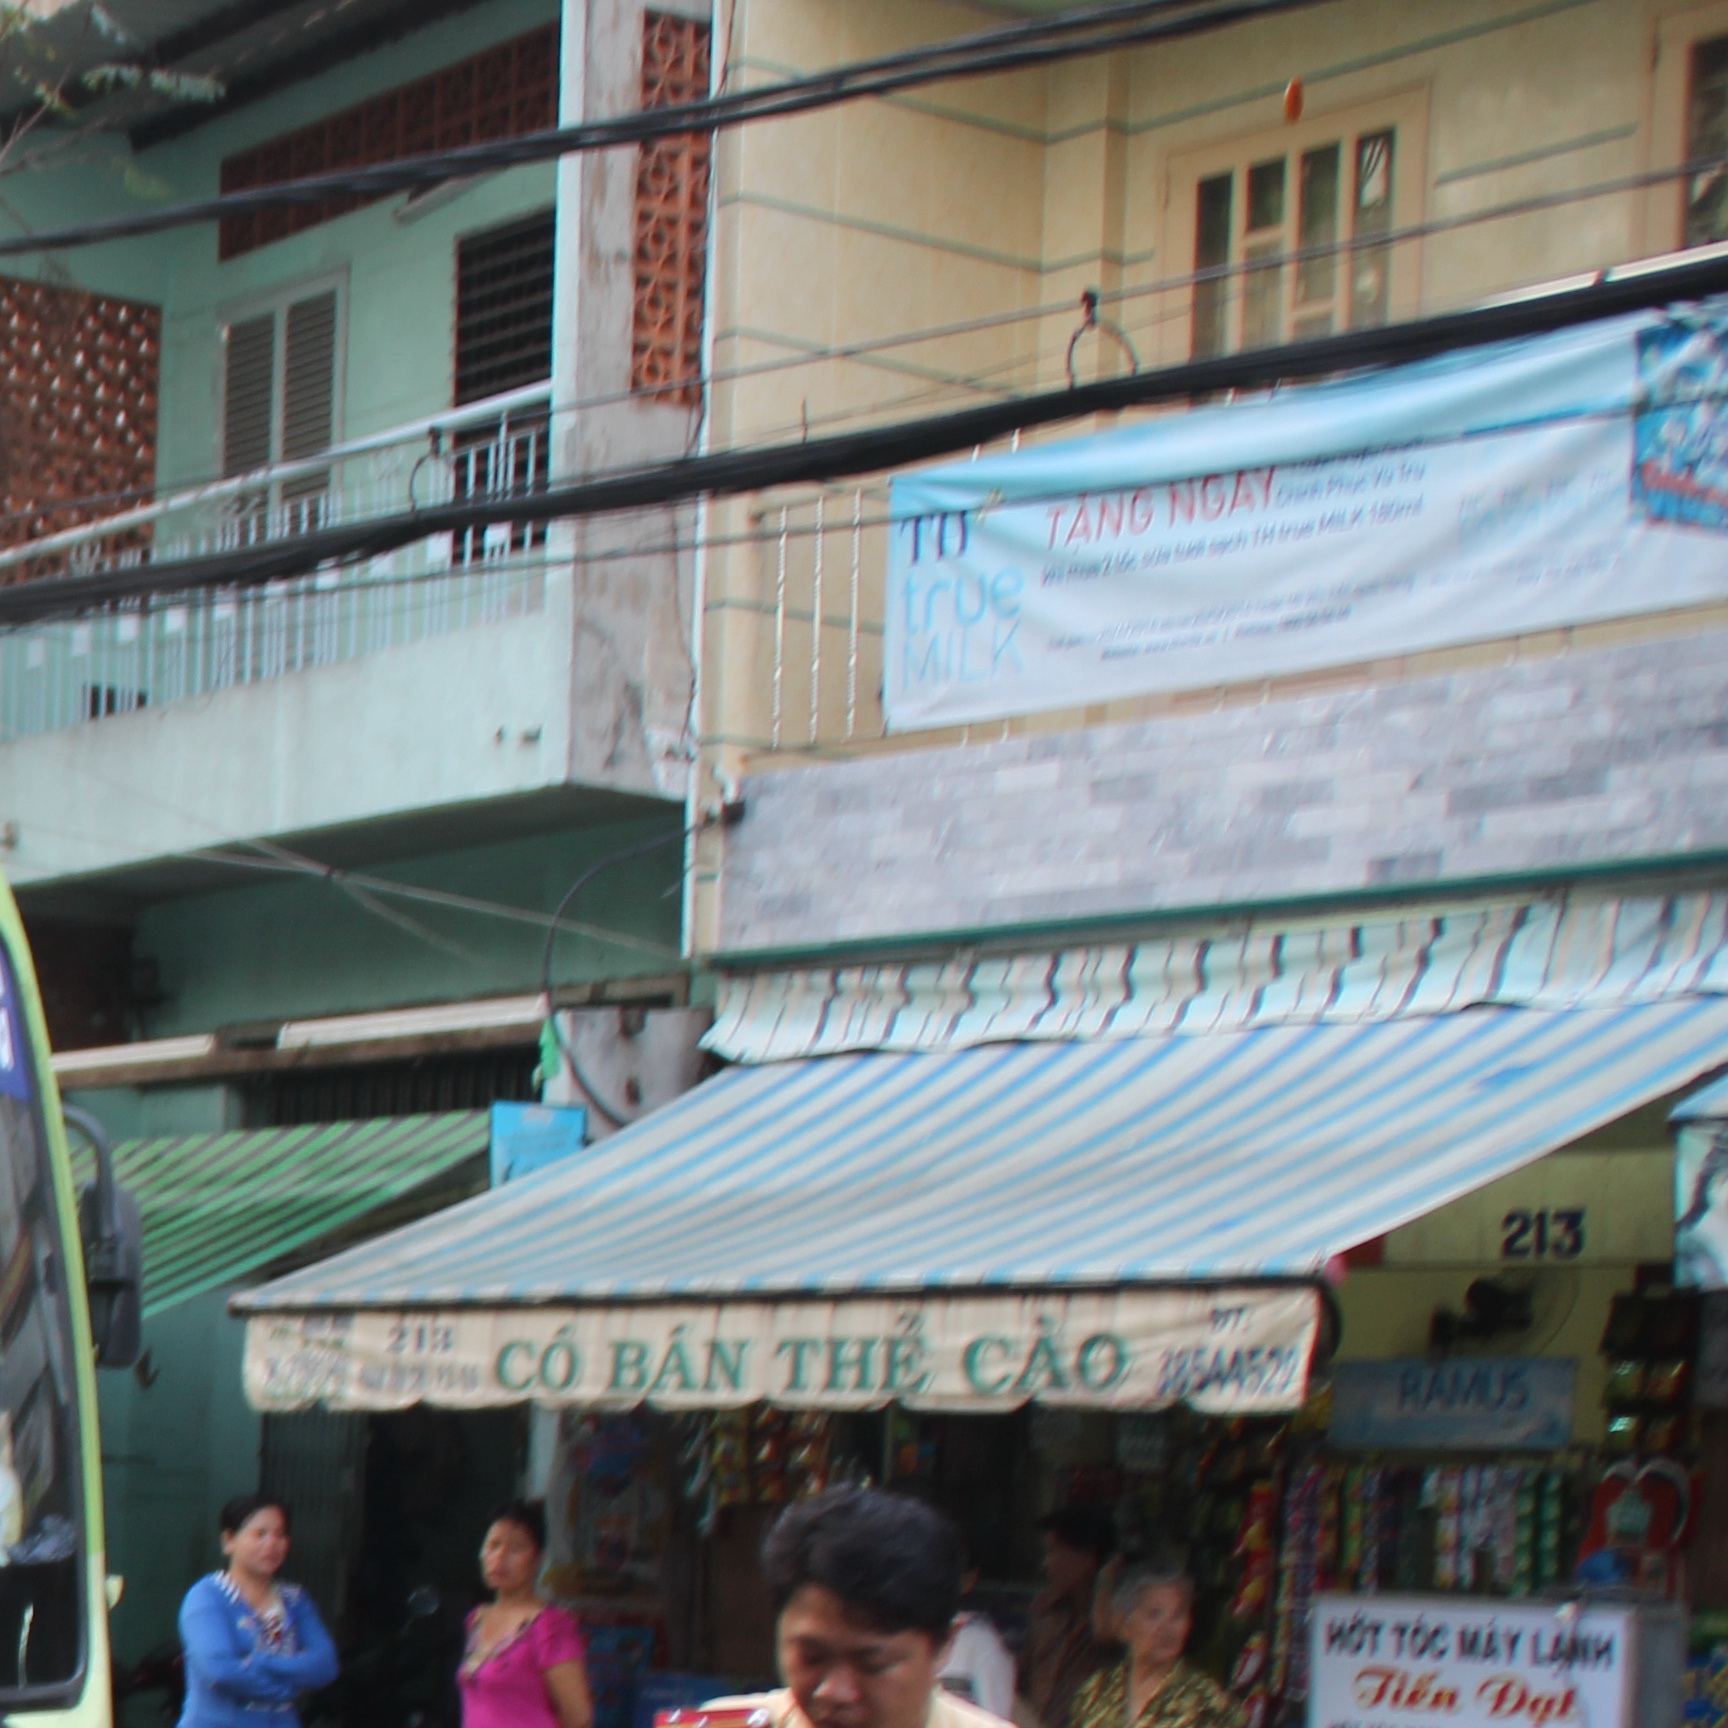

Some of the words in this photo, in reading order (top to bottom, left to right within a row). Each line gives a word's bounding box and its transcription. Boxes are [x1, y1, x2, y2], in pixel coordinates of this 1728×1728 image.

[905, 567, 1025, 634] true
[901, 616, 1025, 694] MILK
[1501, 1207, 1587, 1260] 213
[493, 1323, 582, 1394] CÓ
[608, 1323, 750, 1394] BÁN
[775, 1311, 937, 1395] THẺ
[962, 1318, 1133, 1395] CÀO
[1324, 1608, 1383, 1657] HỚT
[1390, 1610, 1451, 1660] TÓC
[1456, 1615, 1524, 1666] MÁY
